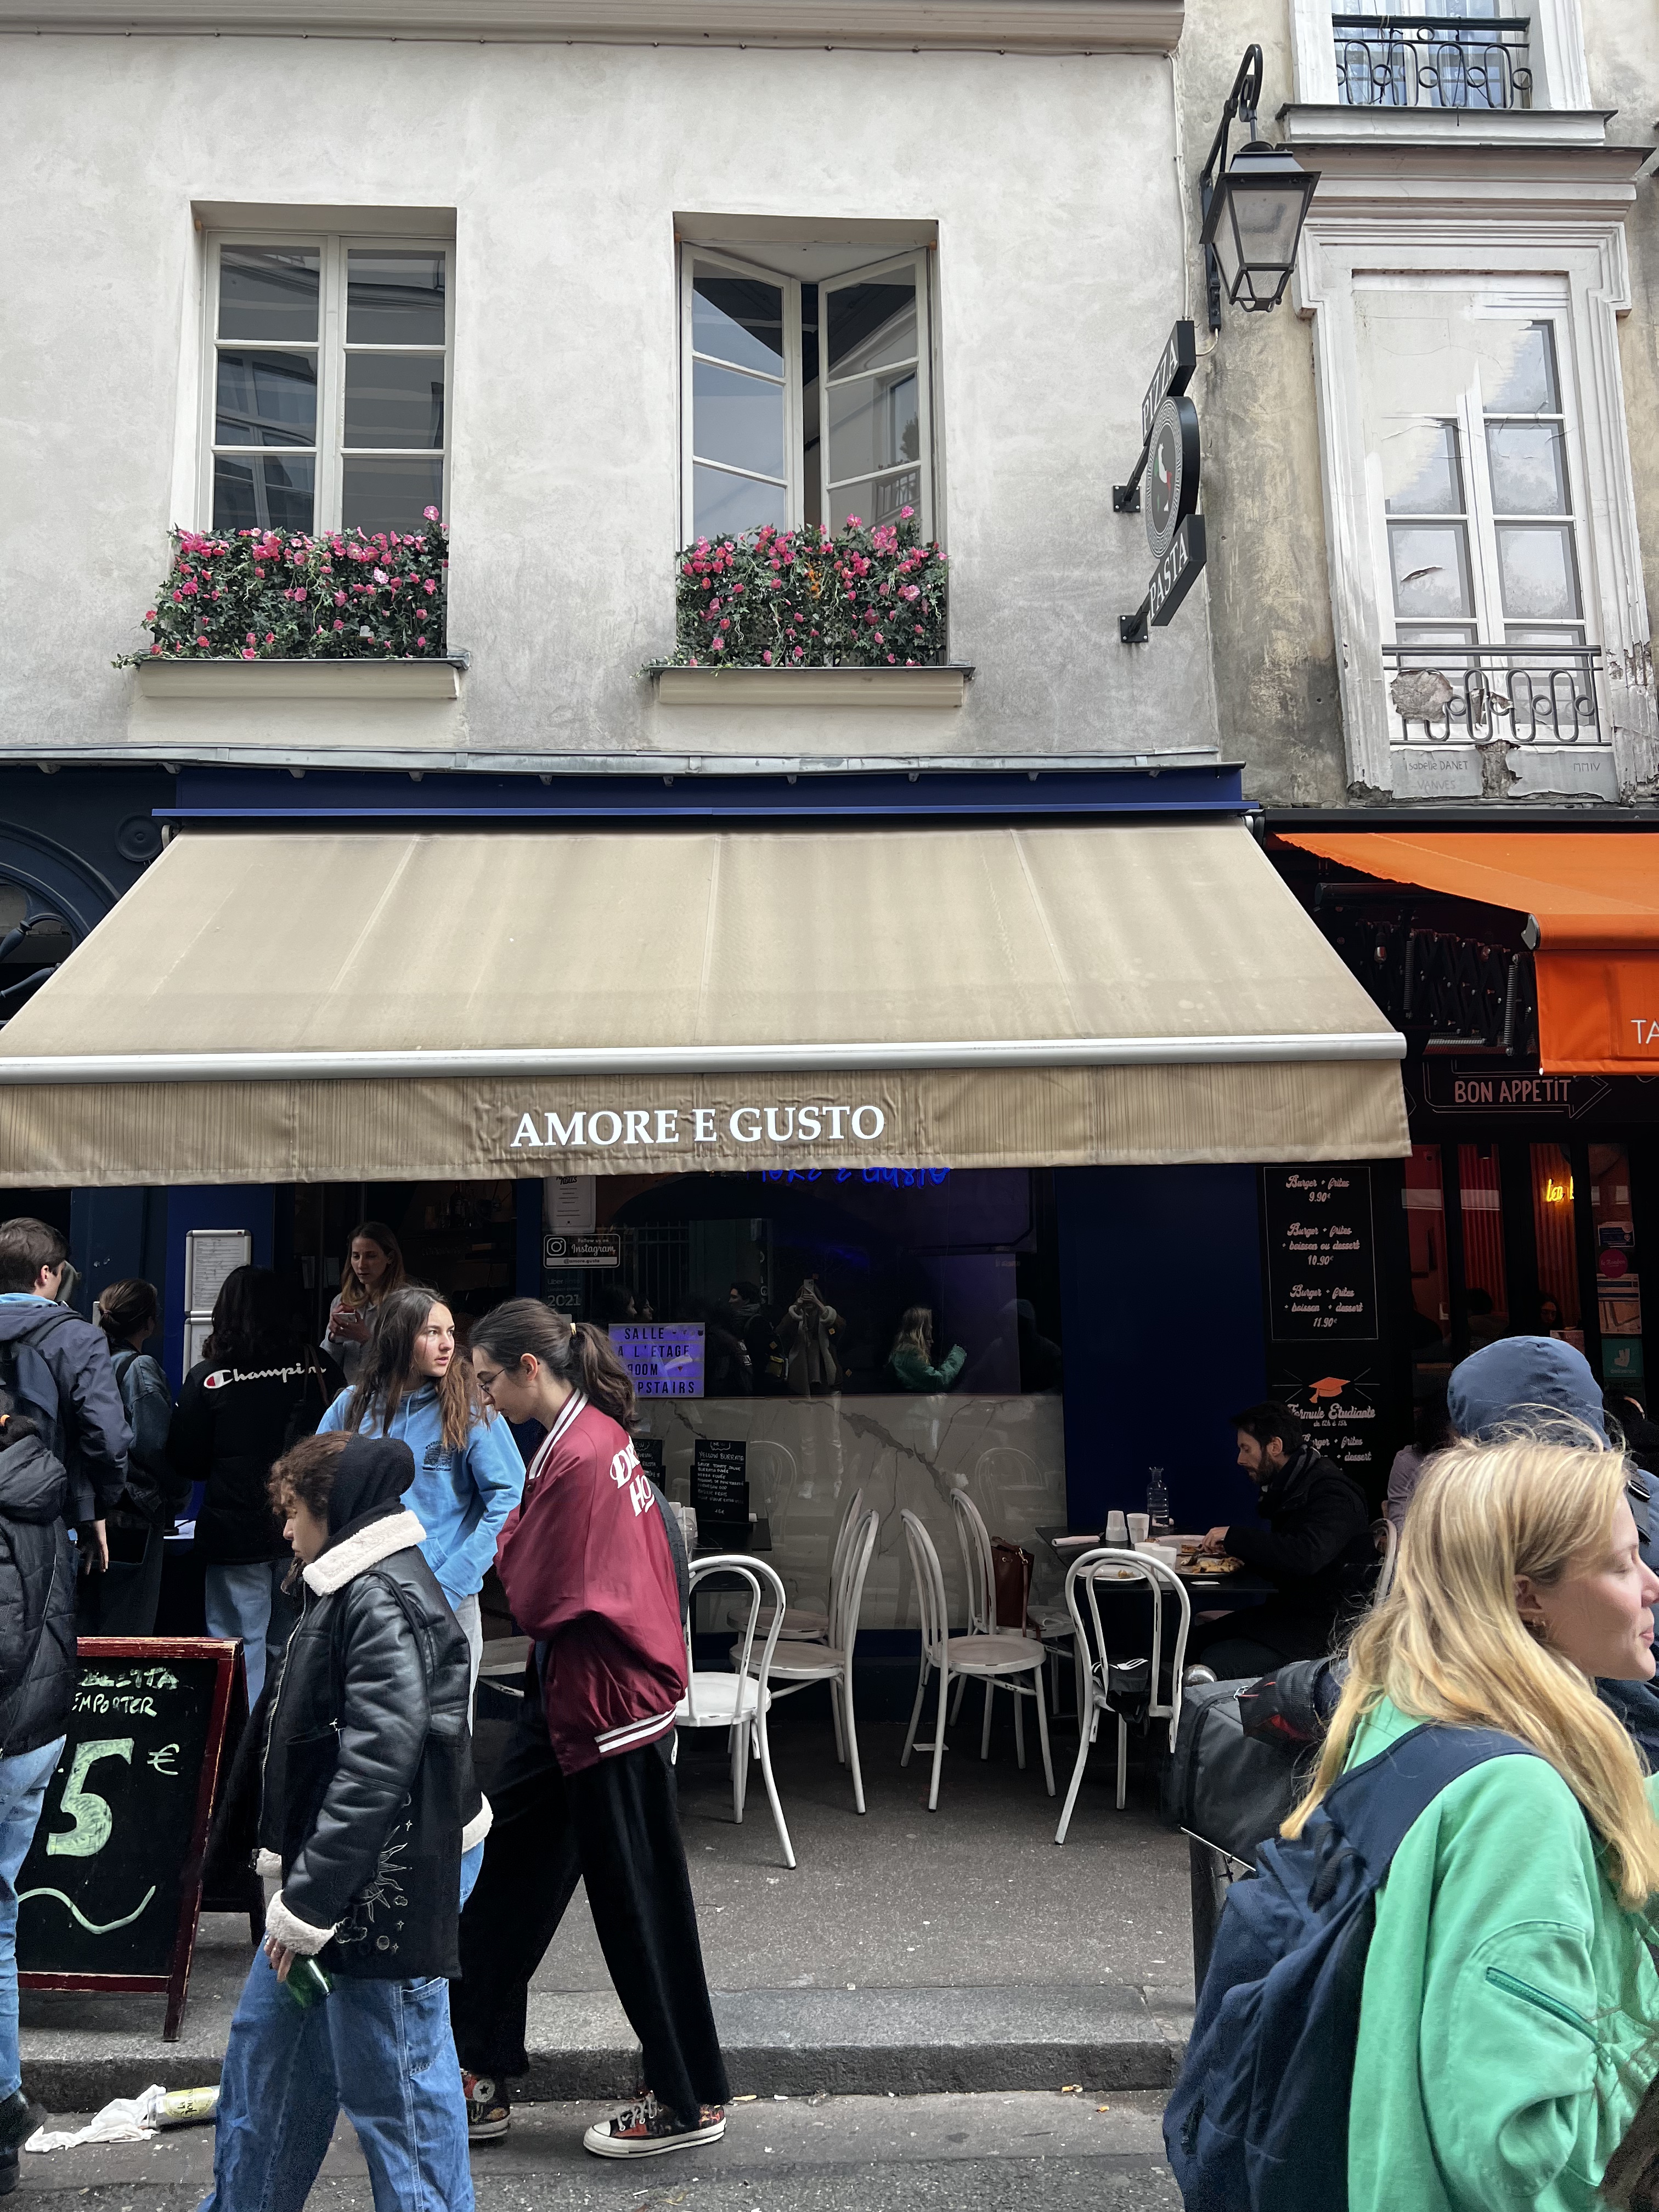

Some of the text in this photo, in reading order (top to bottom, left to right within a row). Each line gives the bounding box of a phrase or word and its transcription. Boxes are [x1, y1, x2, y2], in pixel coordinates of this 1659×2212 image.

[1143, 339, 1178, 439] PIZZA
[1149, 532, 1188, 620] PASTA
[1405, 760, 1468, 771] Isabelle DANET
[1417, 780, 1457, 790] VANVES
[1455, 1081, 1492, 1103] BON
[510, 1105, 885, 1148] AMORE E GUSTO
[1285, 1174, 1318, 1190] Burger
[1328, 1177, 1350, 1190] frites
[1287, 1222, 1319, 1238] Burger
[1329, 1225, 1352, 1238] frites
[571, 1244, 616, 1256] Instagram
[1289, 1240, 1318, 1250] boisson
[1332, 1239, 1361, 1250] dessert
[1290, 1284, 1322, 1300] Burger
[1331, 1287, 1355, 1300] frites
[548, 1294, 581, 1306] 2021
[1291, 1302, 1320, 1312] boisson
[1335, 1302, 1363, 1312] dessert
[624, 1328, 664, 1340] SALLE
[634, 1345, 689, 1357] L'ETAGE
[637, 1381, 694, 1393] PSTAIRS
[1287, 1403, 1376, 1420] Formule Etudiante
[1302, 1434, 1330, 1449] Brger
[1341, 1436, 1363, 1449] frites
[698, 1451, 744, 1462] YELLOW BURRATA
[1344, 1451, 1372, 1462] dessert
[46, 1738, 179, 1857] 5 €
